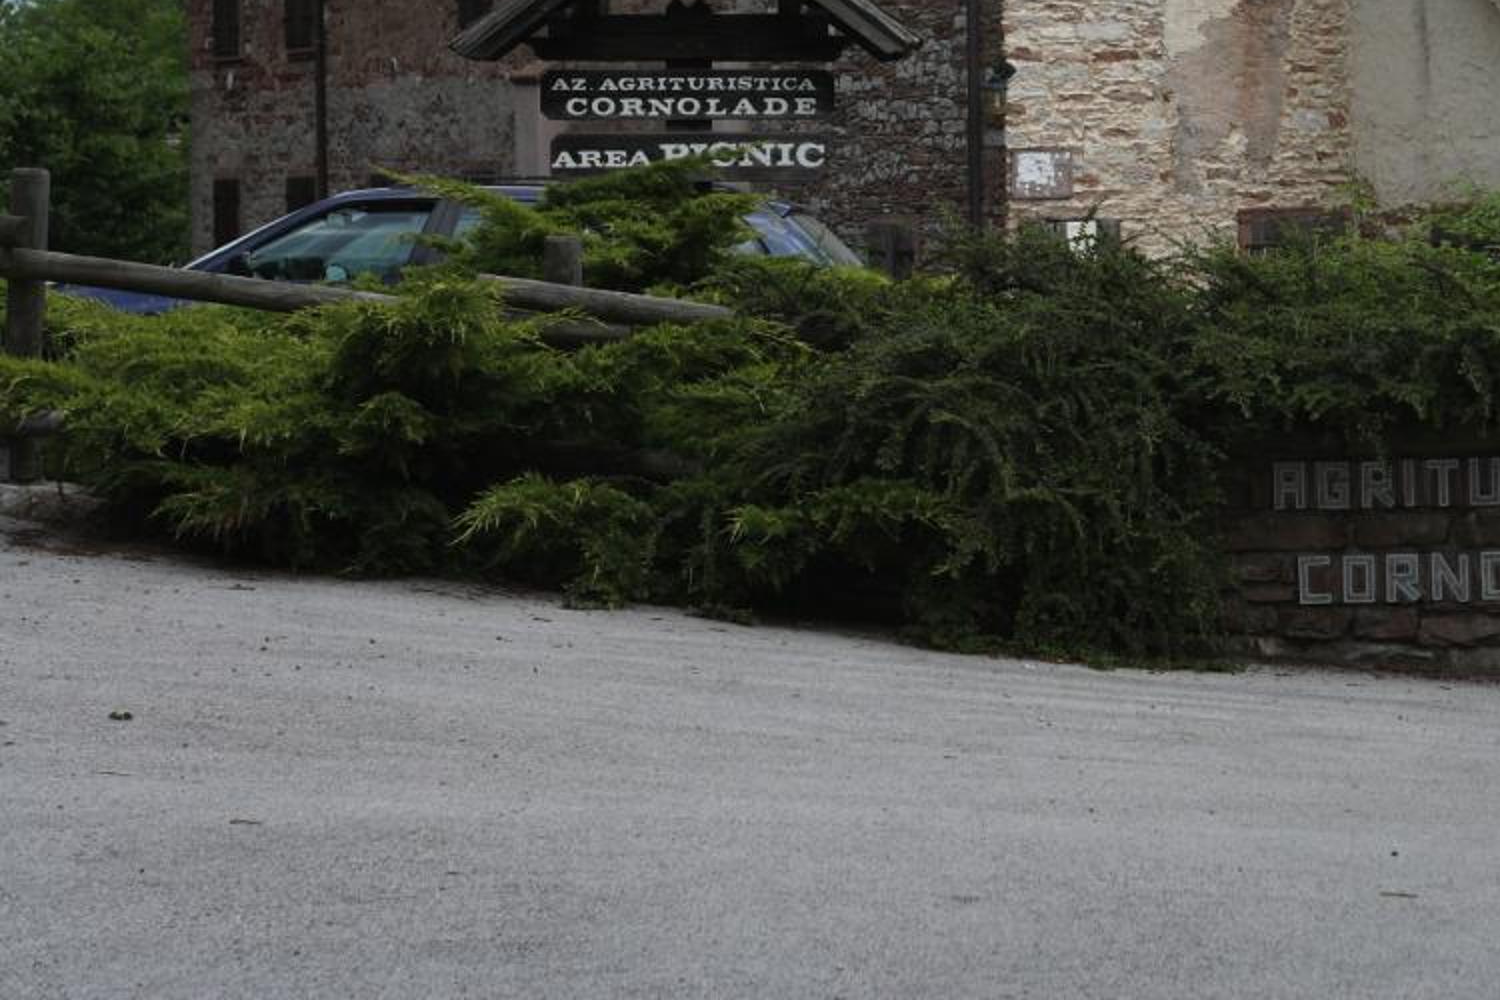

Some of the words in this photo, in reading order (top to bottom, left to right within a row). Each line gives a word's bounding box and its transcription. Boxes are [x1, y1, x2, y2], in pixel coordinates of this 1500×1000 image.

[551, 77, 594, 92] AZ.
[600, 76, 816, 92] AGRITURISTICA
[566, 97, 817, 117] CORNOLADE
[552, 150, 650, 168] AREA
